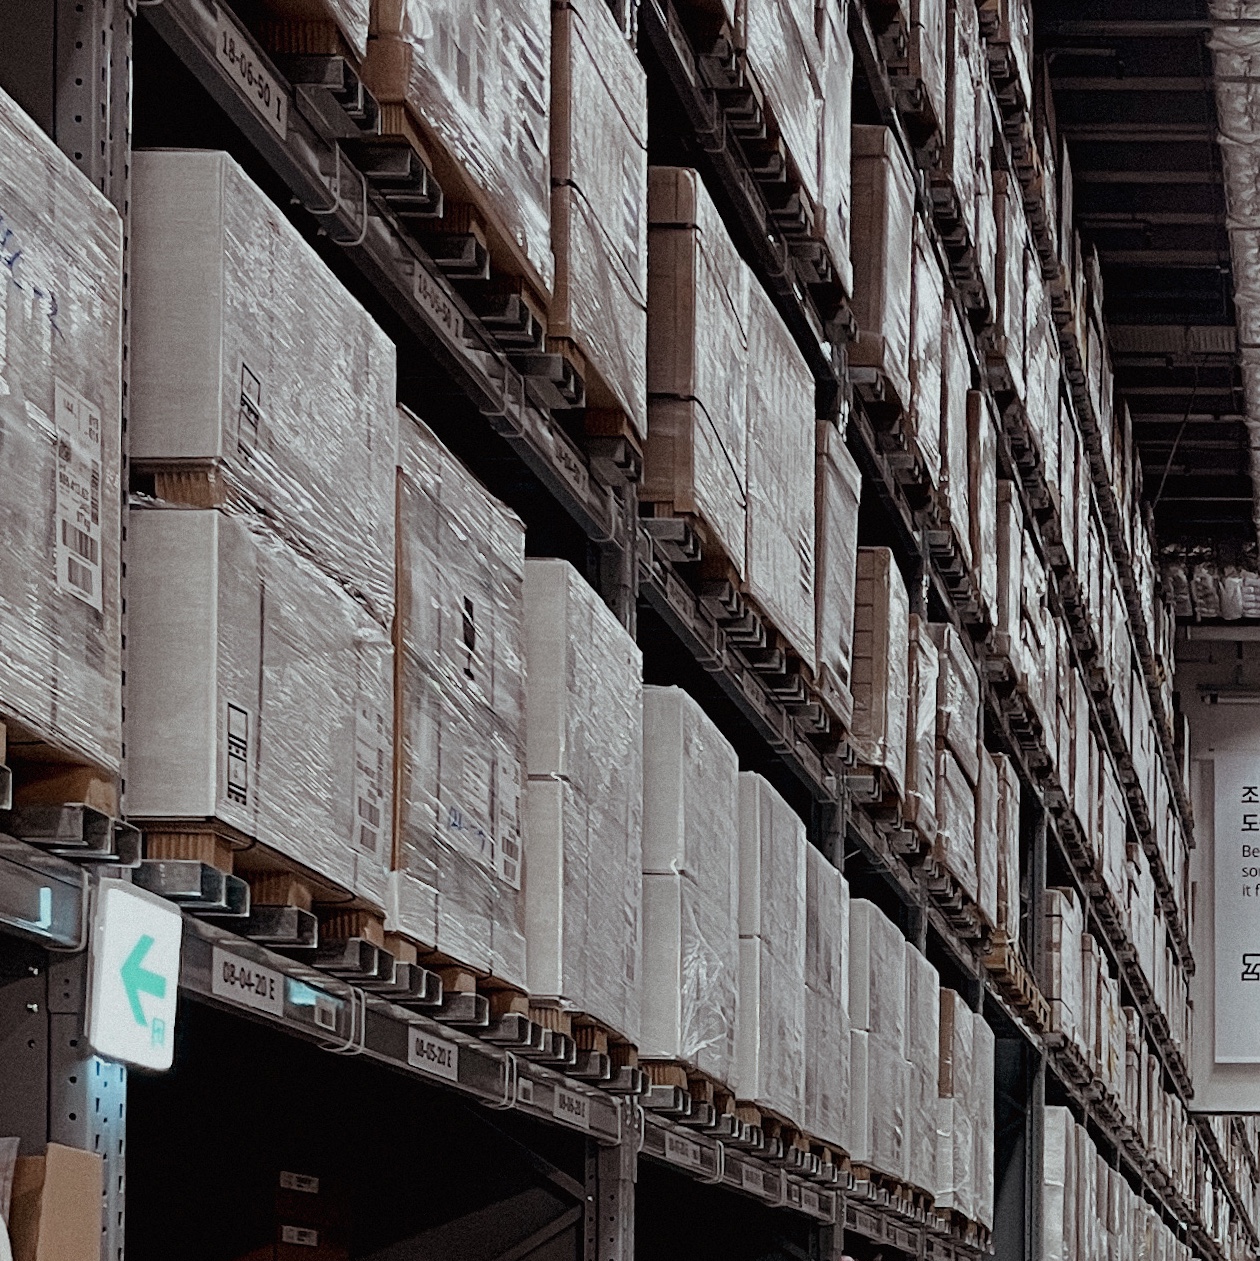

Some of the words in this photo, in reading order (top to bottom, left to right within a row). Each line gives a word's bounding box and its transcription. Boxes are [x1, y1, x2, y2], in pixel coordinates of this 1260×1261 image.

[222, 31, 271, 107] 18-06-50
[1242, 884, 1251, 897] it
[223, 961, 267, 997] 08-04-20
[269, 977, 275, 1001] E
